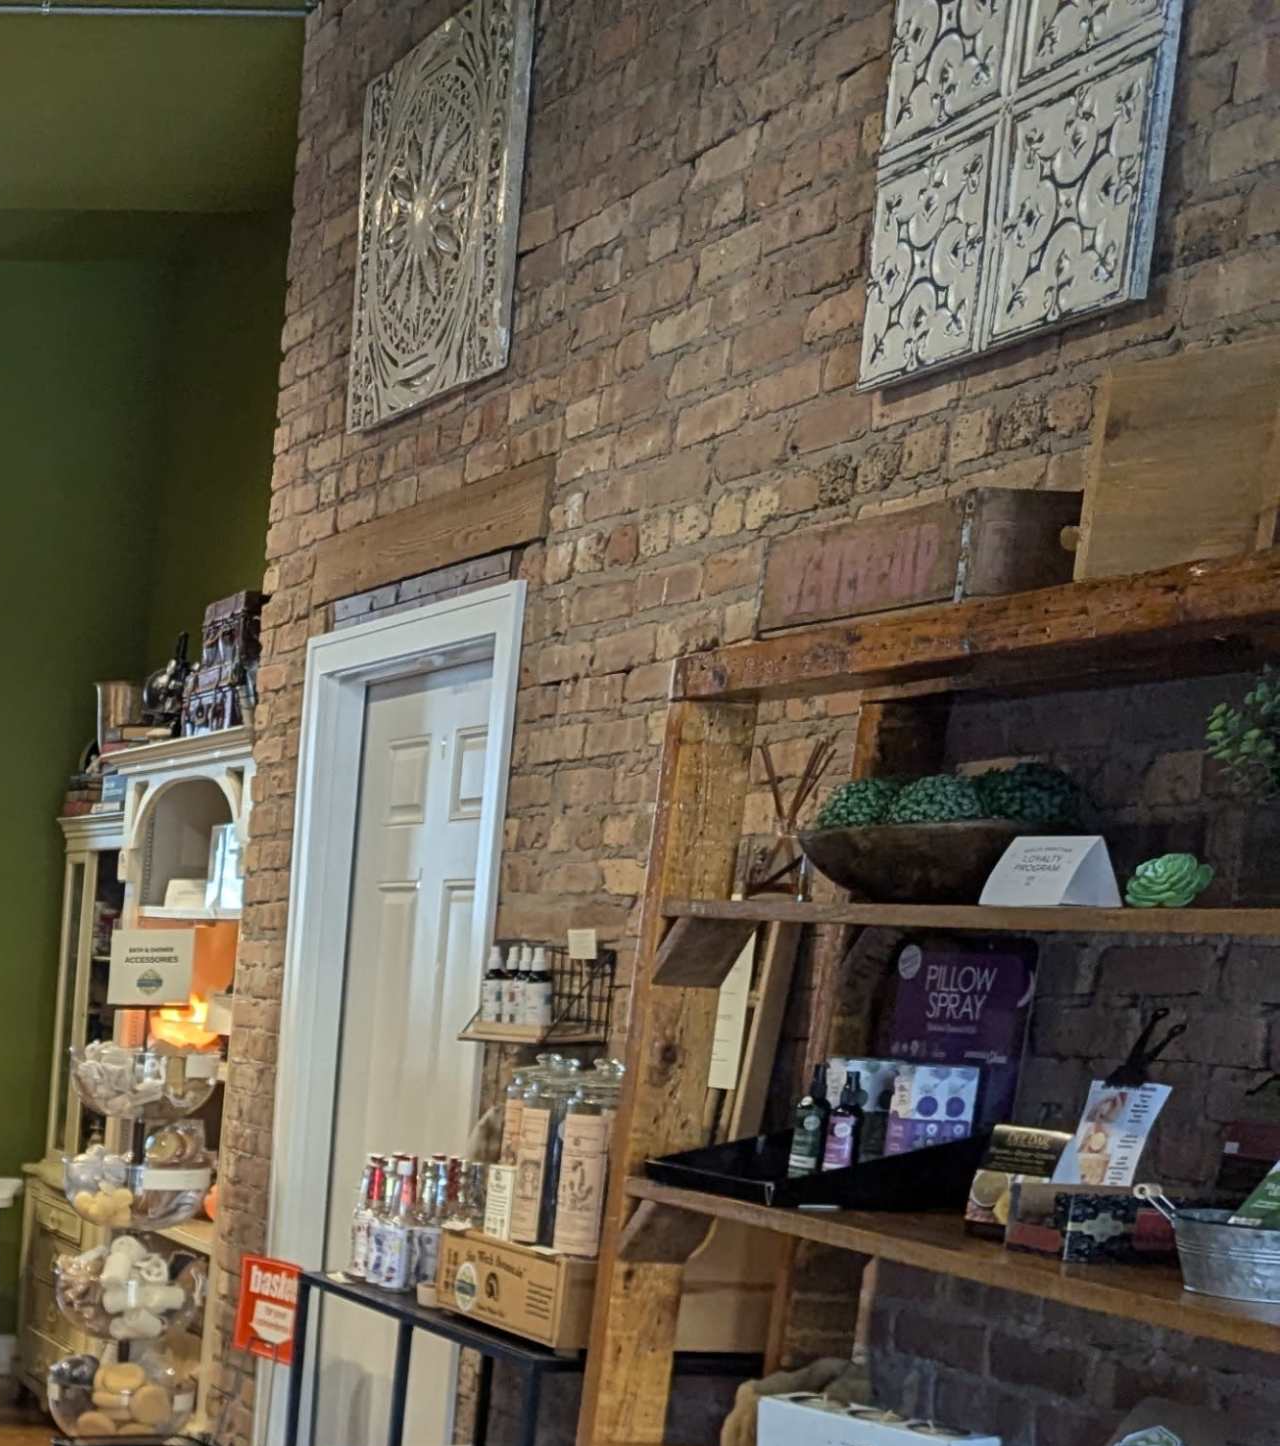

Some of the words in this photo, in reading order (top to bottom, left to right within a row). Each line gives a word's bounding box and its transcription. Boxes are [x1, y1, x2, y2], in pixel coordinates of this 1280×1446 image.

[1013, 863, 1061, 872] PROGRAM
[1022, 855, 1062, 863] LOYALTY
[924, 965, 998, 993] PILLOW
[926, 992, 987, 1021] SPRAY
[249, 1264, 298, 1304] baske
